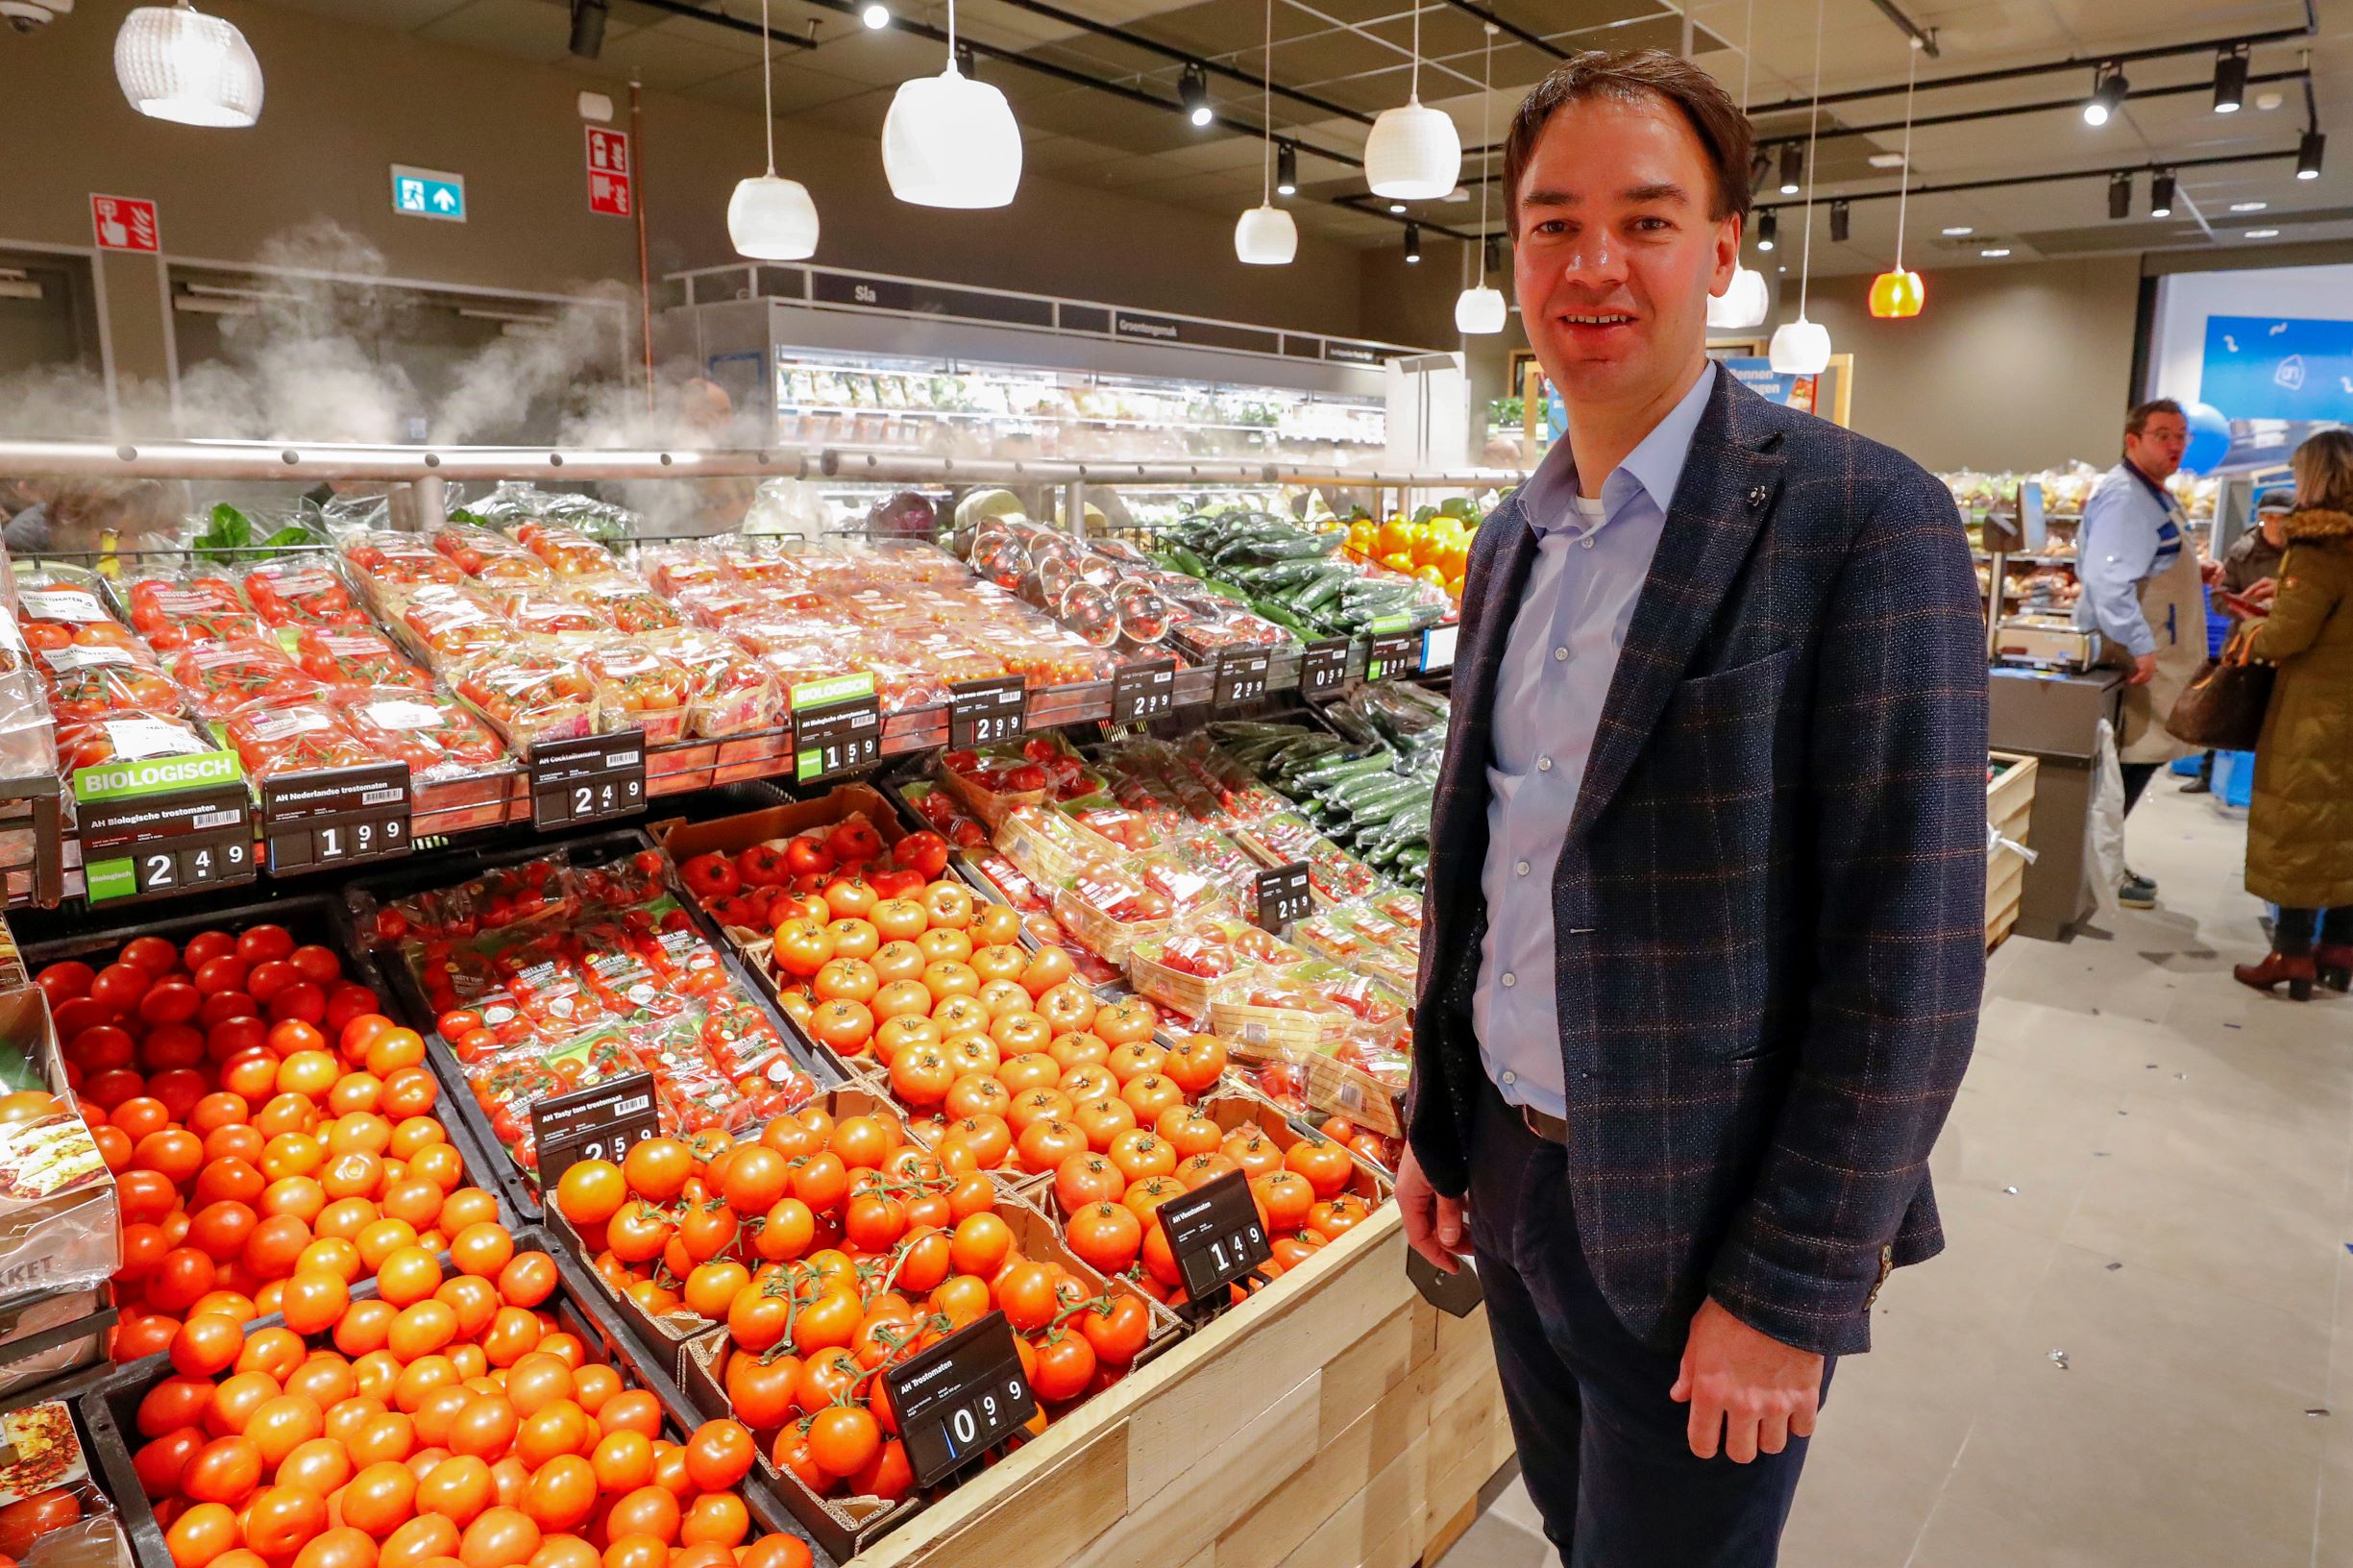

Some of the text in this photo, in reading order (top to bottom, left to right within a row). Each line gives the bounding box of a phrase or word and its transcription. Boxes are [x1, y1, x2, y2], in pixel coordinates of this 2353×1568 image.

[855, 284, 876, 304] Sla
[797, 677, 870, 703] BIOLOGISCH
[85, 758, 232, 794] BIOLOGISCH
[275, 782, 388, 803] AH Nederlandse trostomaten
[90, 804, 216, 828] AH Biologische trostomaten
[89, 870, 132, 884] Biologisch
[542, 1094, 623, 1123] AH Tasty tom trostomaat
[1172, 1213, 1181, 1224] AH
[901, 1360, 953, 1395] AH Trostomaten
